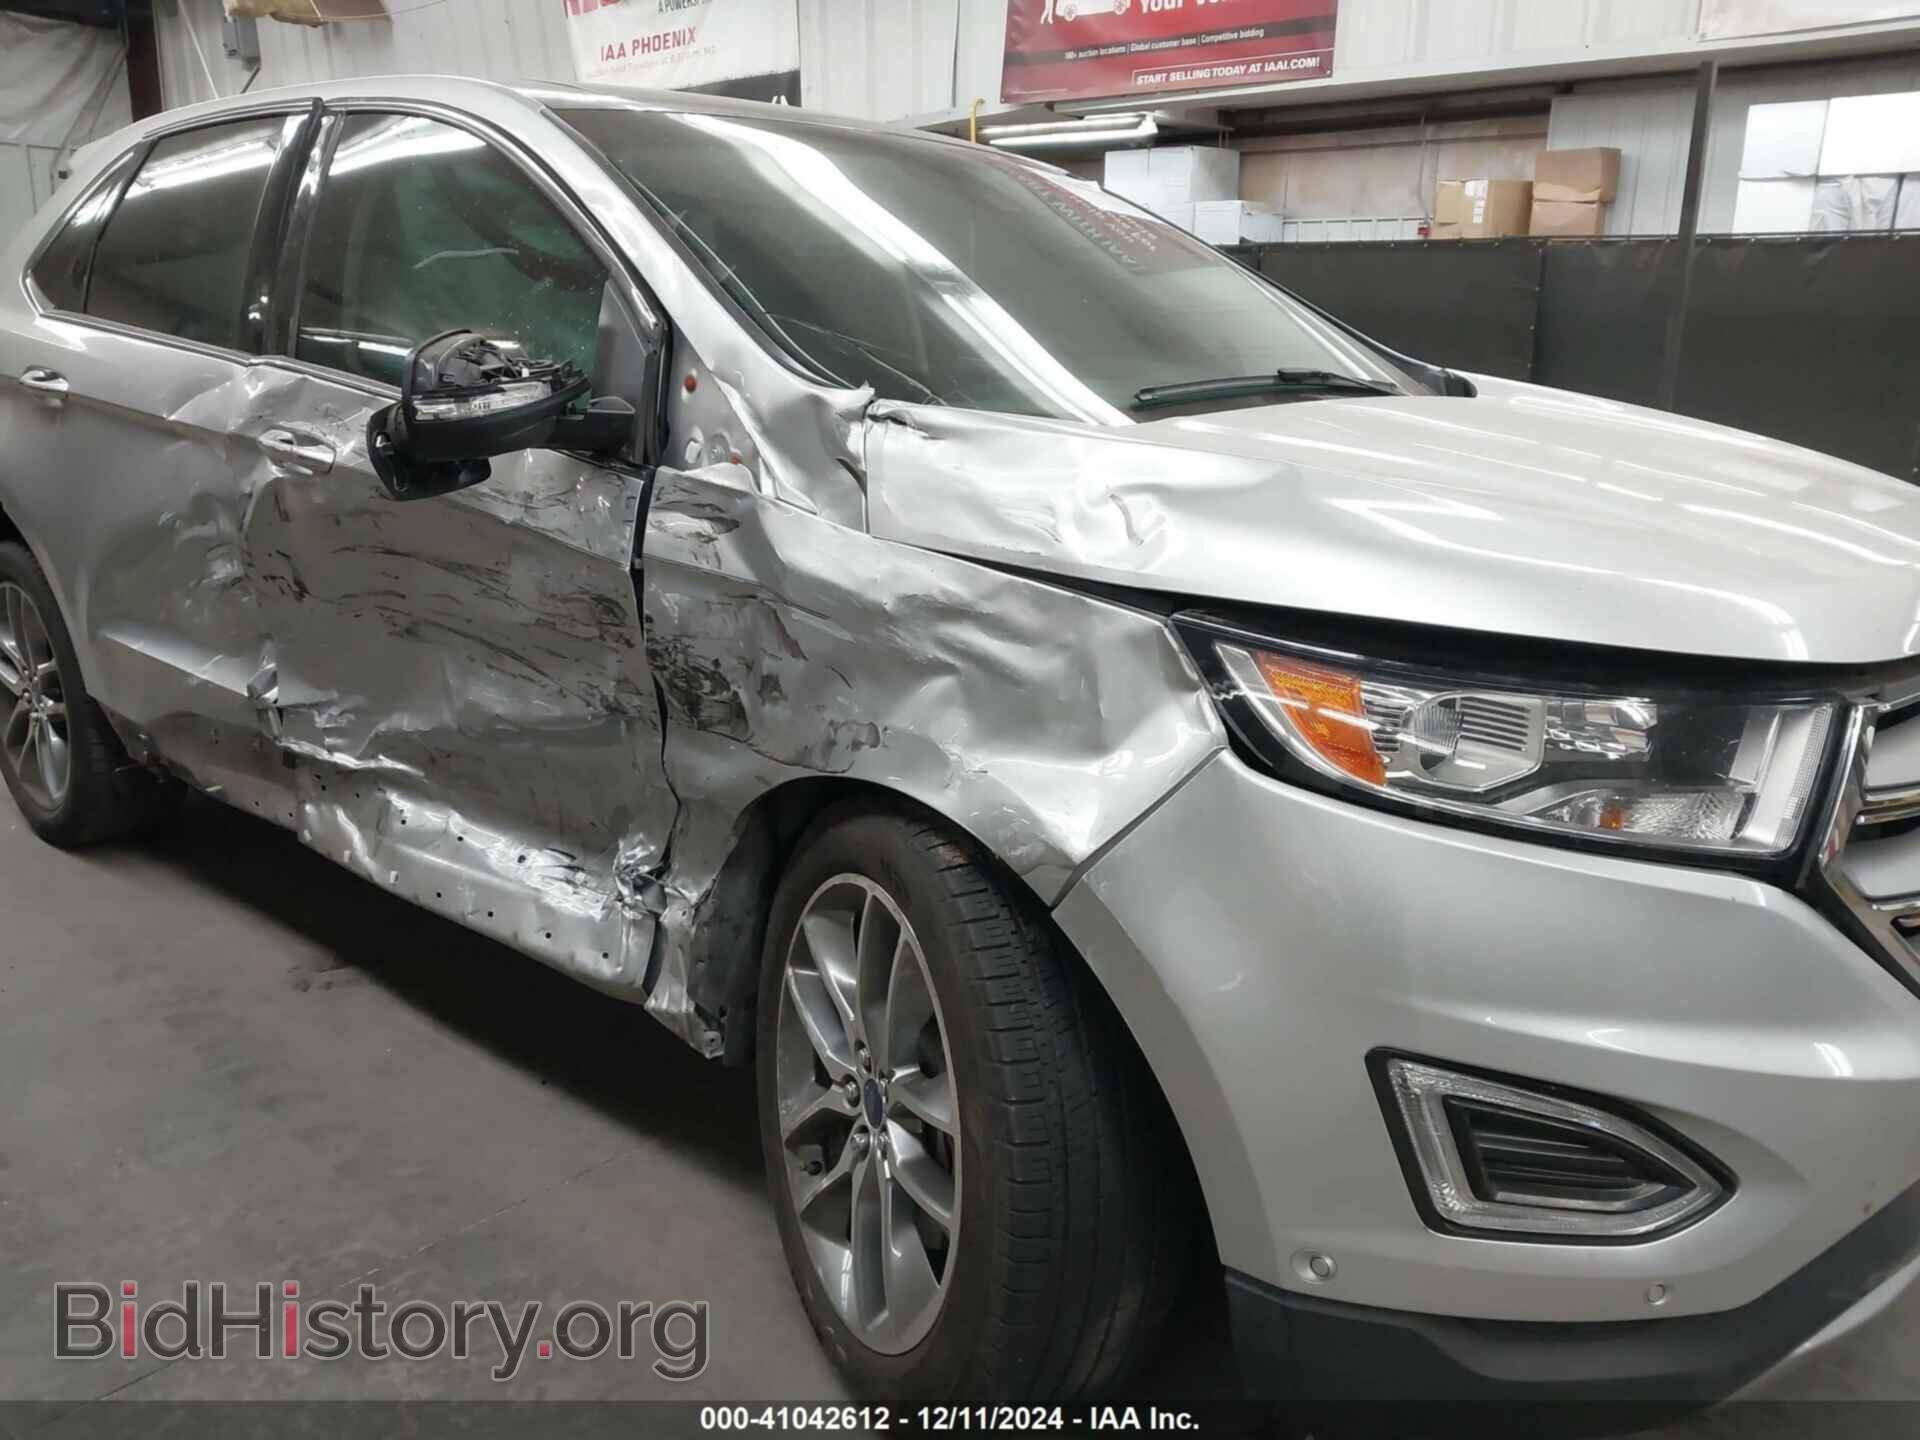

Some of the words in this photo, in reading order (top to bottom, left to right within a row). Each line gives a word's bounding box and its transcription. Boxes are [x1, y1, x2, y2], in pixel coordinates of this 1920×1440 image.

[600, 42, 627, 62] IAA
[632, 26, 697, 57] PHOENIX
[1151, 39, 1180, 50] customer
[1201, 32, 1239, 44] Competitive
[1240, 28, 1264, 39] bidding
[1136, 72, 1169, 86] START
[1169, 68, 1212, 82] SELLING
[1212, 63, 1247, 77] TODAY
[1248, 62, 1262, 74] AT
[1264, 56, 1320, 73] IAAI.COM!
